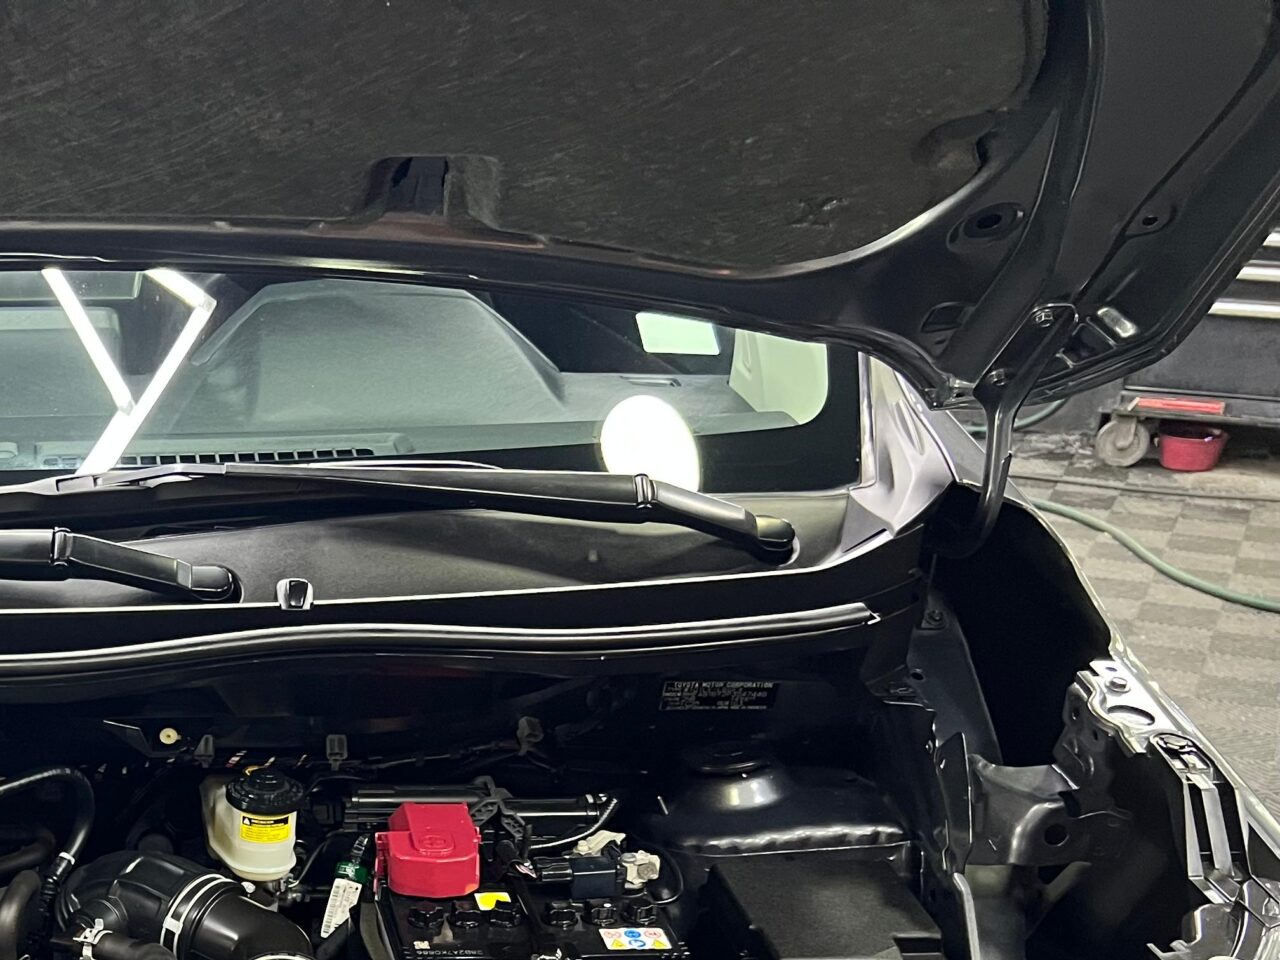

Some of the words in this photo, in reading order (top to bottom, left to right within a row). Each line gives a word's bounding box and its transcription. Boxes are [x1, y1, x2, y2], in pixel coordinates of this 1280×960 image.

[674, 681, 699, 689] TOYOTA
[702, 681, 725, 689] MOTOR
[726, 681, 774, 689] CORPORATION
